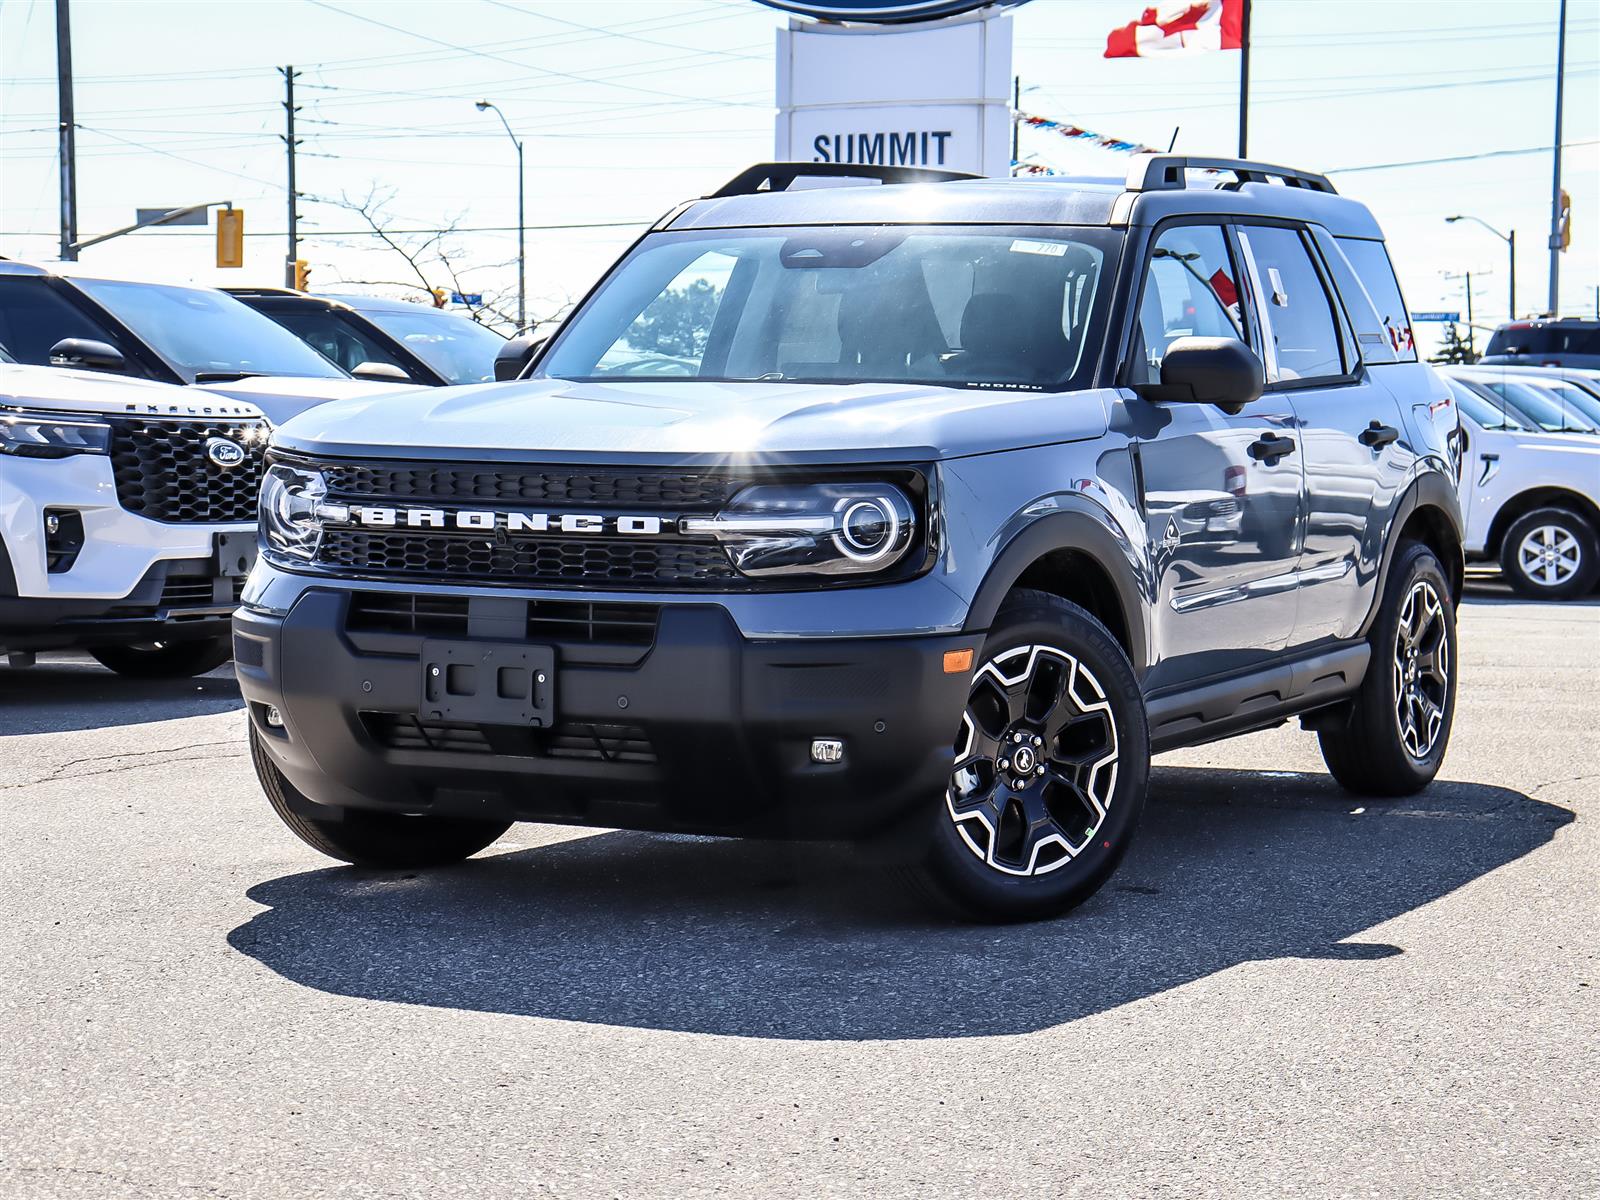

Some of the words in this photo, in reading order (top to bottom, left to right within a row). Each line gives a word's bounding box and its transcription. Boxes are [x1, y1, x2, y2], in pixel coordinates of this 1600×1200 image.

[813, 131, 952, 166] SUMMIT
[219, 446, 240, 461] Ford
[361, 506, 661, 534] BRONCO
